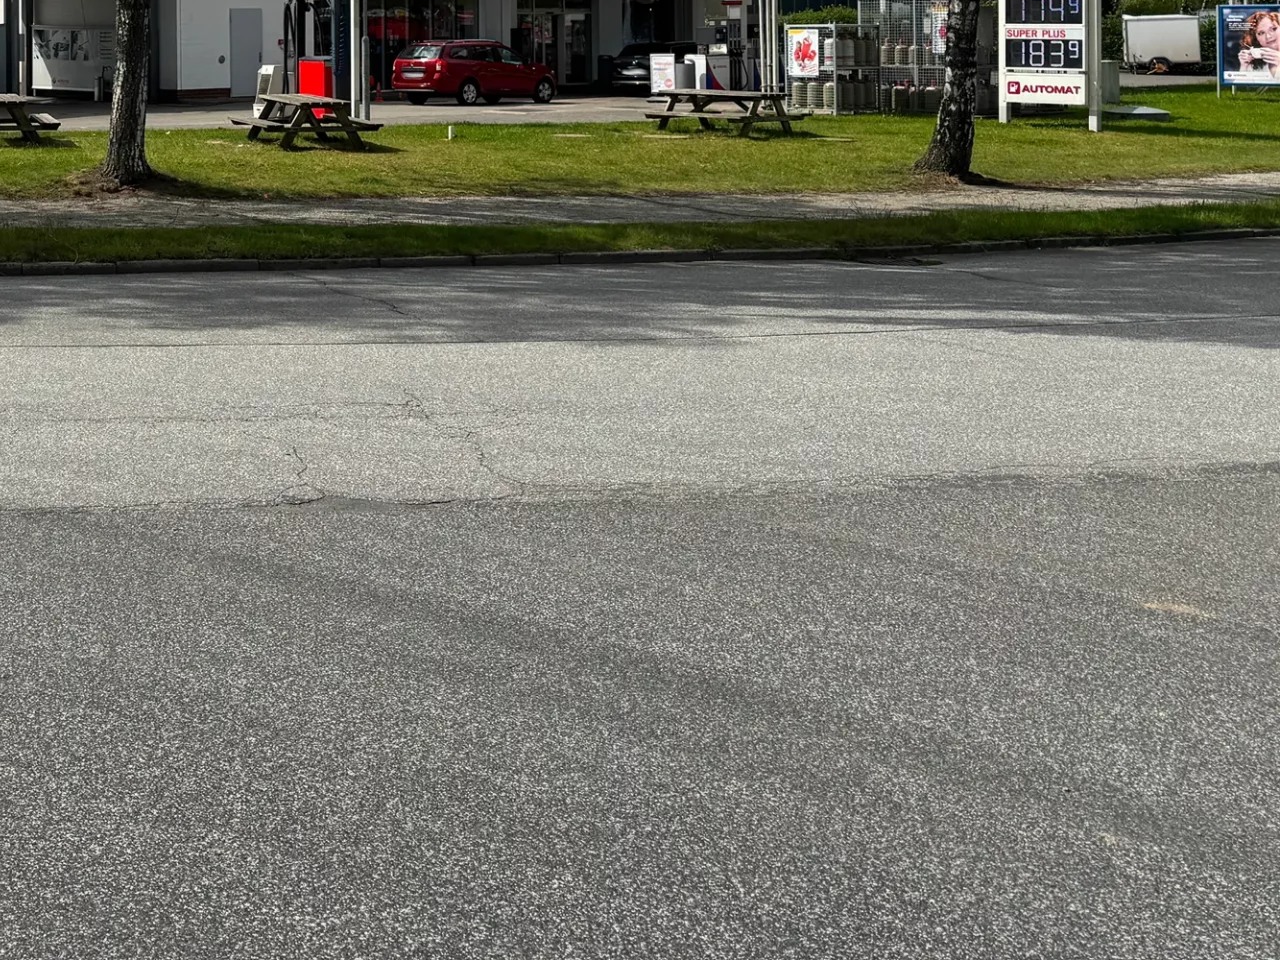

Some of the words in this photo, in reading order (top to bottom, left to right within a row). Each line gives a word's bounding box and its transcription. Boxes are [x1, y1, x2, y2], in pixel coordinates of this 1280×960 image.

[1006, 29, 1038, 38] SUPER
[1042, 29, 1066, 38] PLUS
[1021, 85, 1081, 95] AUTOMAT
